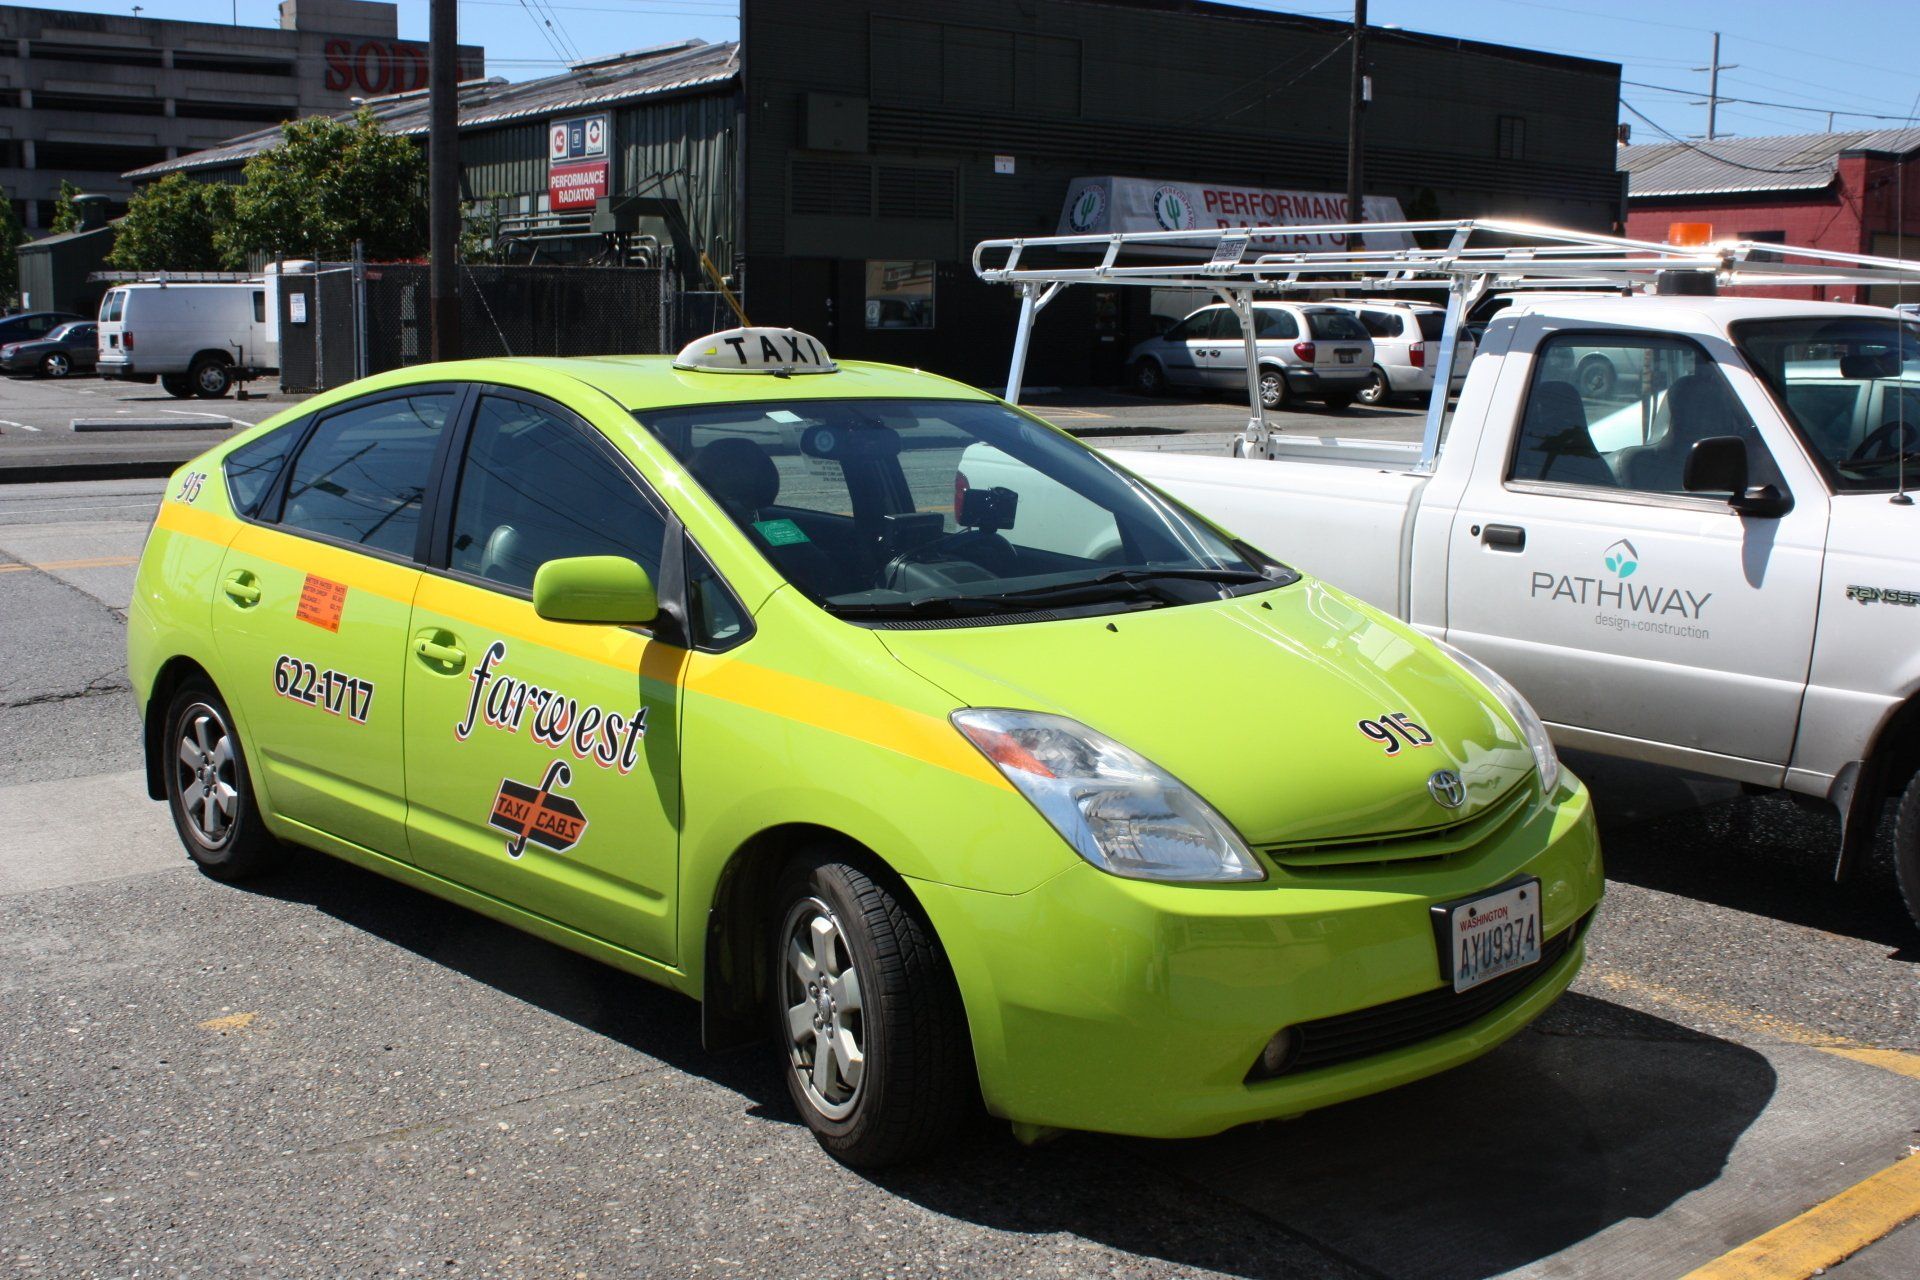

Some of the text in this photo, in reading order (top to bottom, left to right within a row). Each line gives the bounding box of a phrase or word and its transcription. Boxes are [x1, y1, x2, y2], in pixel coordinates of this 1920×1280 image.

[325, 38, 463, 95] SOD
[555, 134, 564, 147] AC
[551, 170, 604, 188] PERFORMANCE
[558, 187, 595, 204] RADIATOR
[723, 335, 821, 366] TAXI
[176, 471, 208, 503] 915
[1531, 571, 1712, 620] PATHWAY
[273, 654, 375, 725] 622-1717
[455, 639, 649, 775] farwest
[1357, 711, 1434, 757] 915
[497, 798, 582, 840] TAXI CABS
[1460, 905, 1509, 932] WASHINGTON
[1461, 913, 1536, 979] AYU9374
